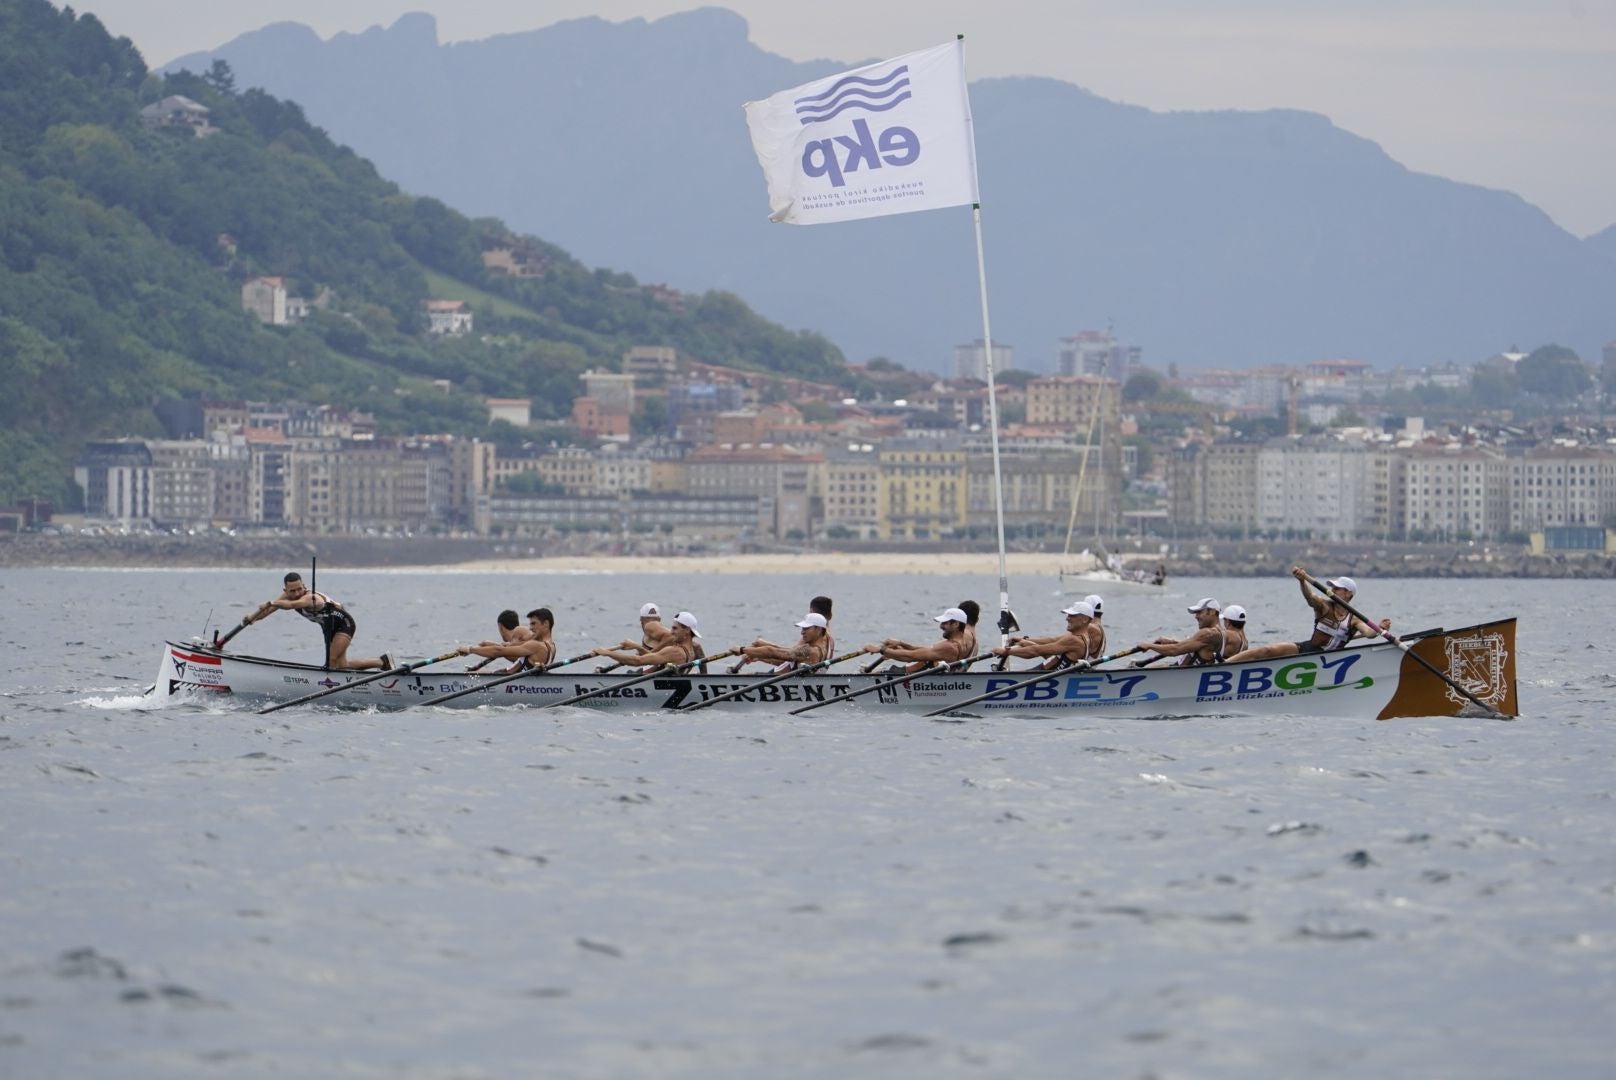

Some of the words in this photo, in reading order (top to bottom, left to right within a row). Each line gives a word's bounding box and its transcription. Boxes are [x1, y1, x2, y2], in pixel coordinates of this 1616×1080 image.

[188, 665, 223, 675] CUPRA
[291, 677, 310, 686] TEPSA
[913, 682, 972, 691] Bizkaialde
[519, 685, 563, 695] Petronor
[1237, 691, 1284, 701] Bizkaia
[1289, 688, 1312, 696] Gas
